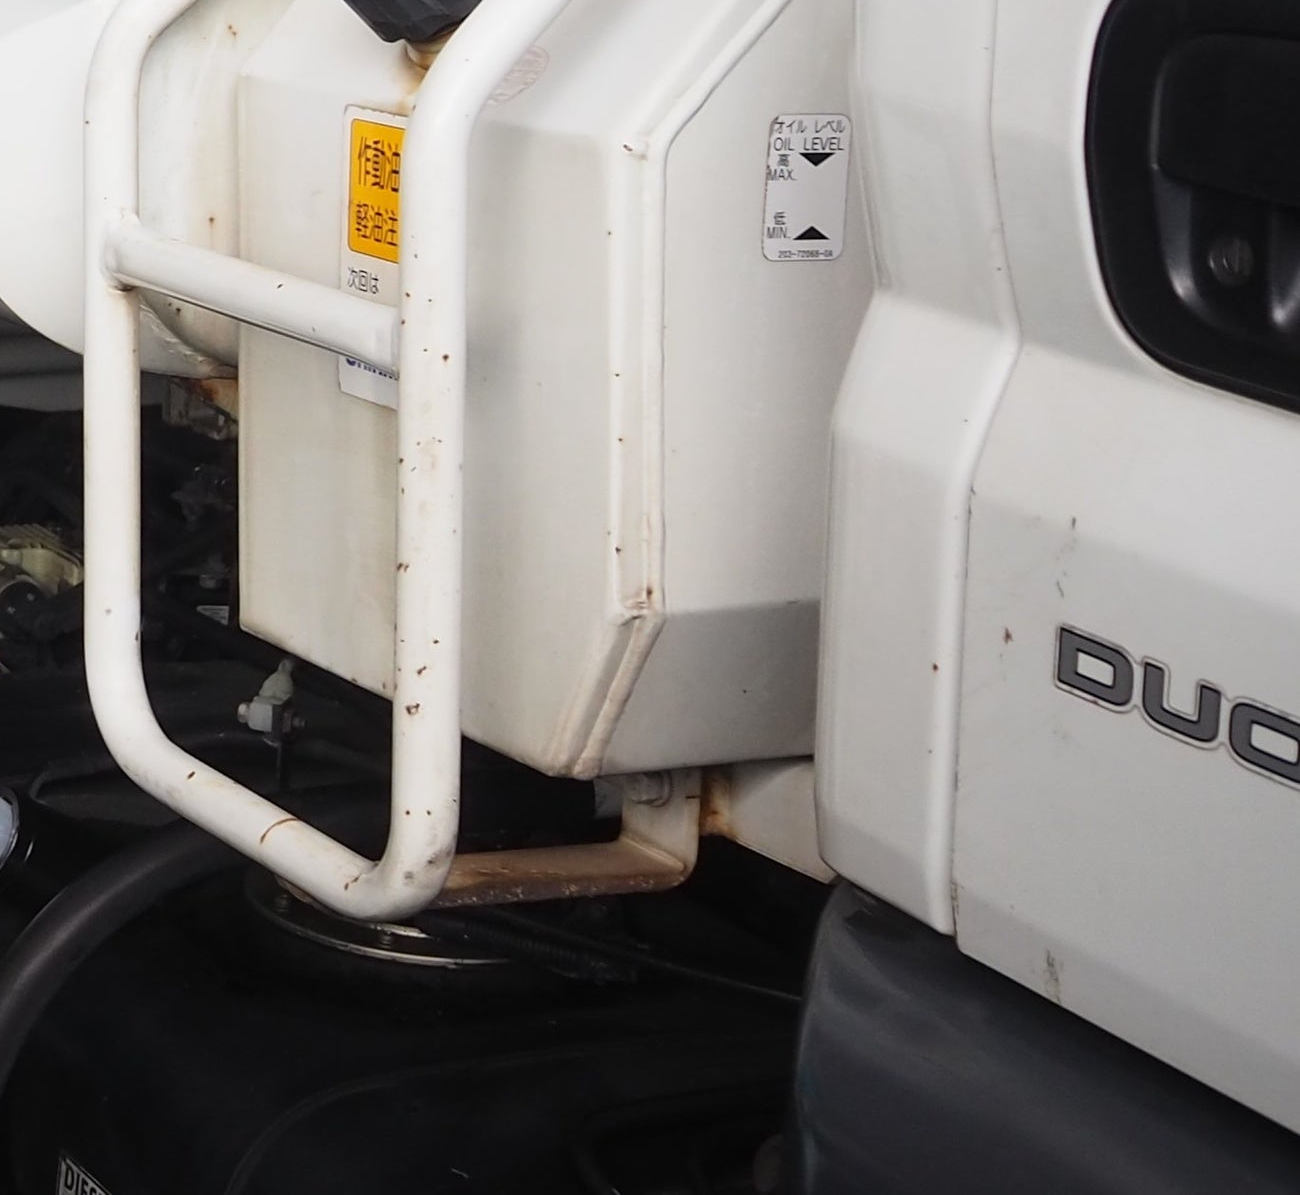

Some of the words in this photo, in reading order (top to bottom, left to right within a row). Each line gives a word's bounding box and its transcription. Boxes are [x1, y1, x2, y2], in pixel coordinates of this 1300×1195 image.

[773, 119, 806, 134] オイル
[814, 119, 846, 134] レベル
[773, 137, 796, 152] OIL
[803, 136, 846, 151] LEVEL
